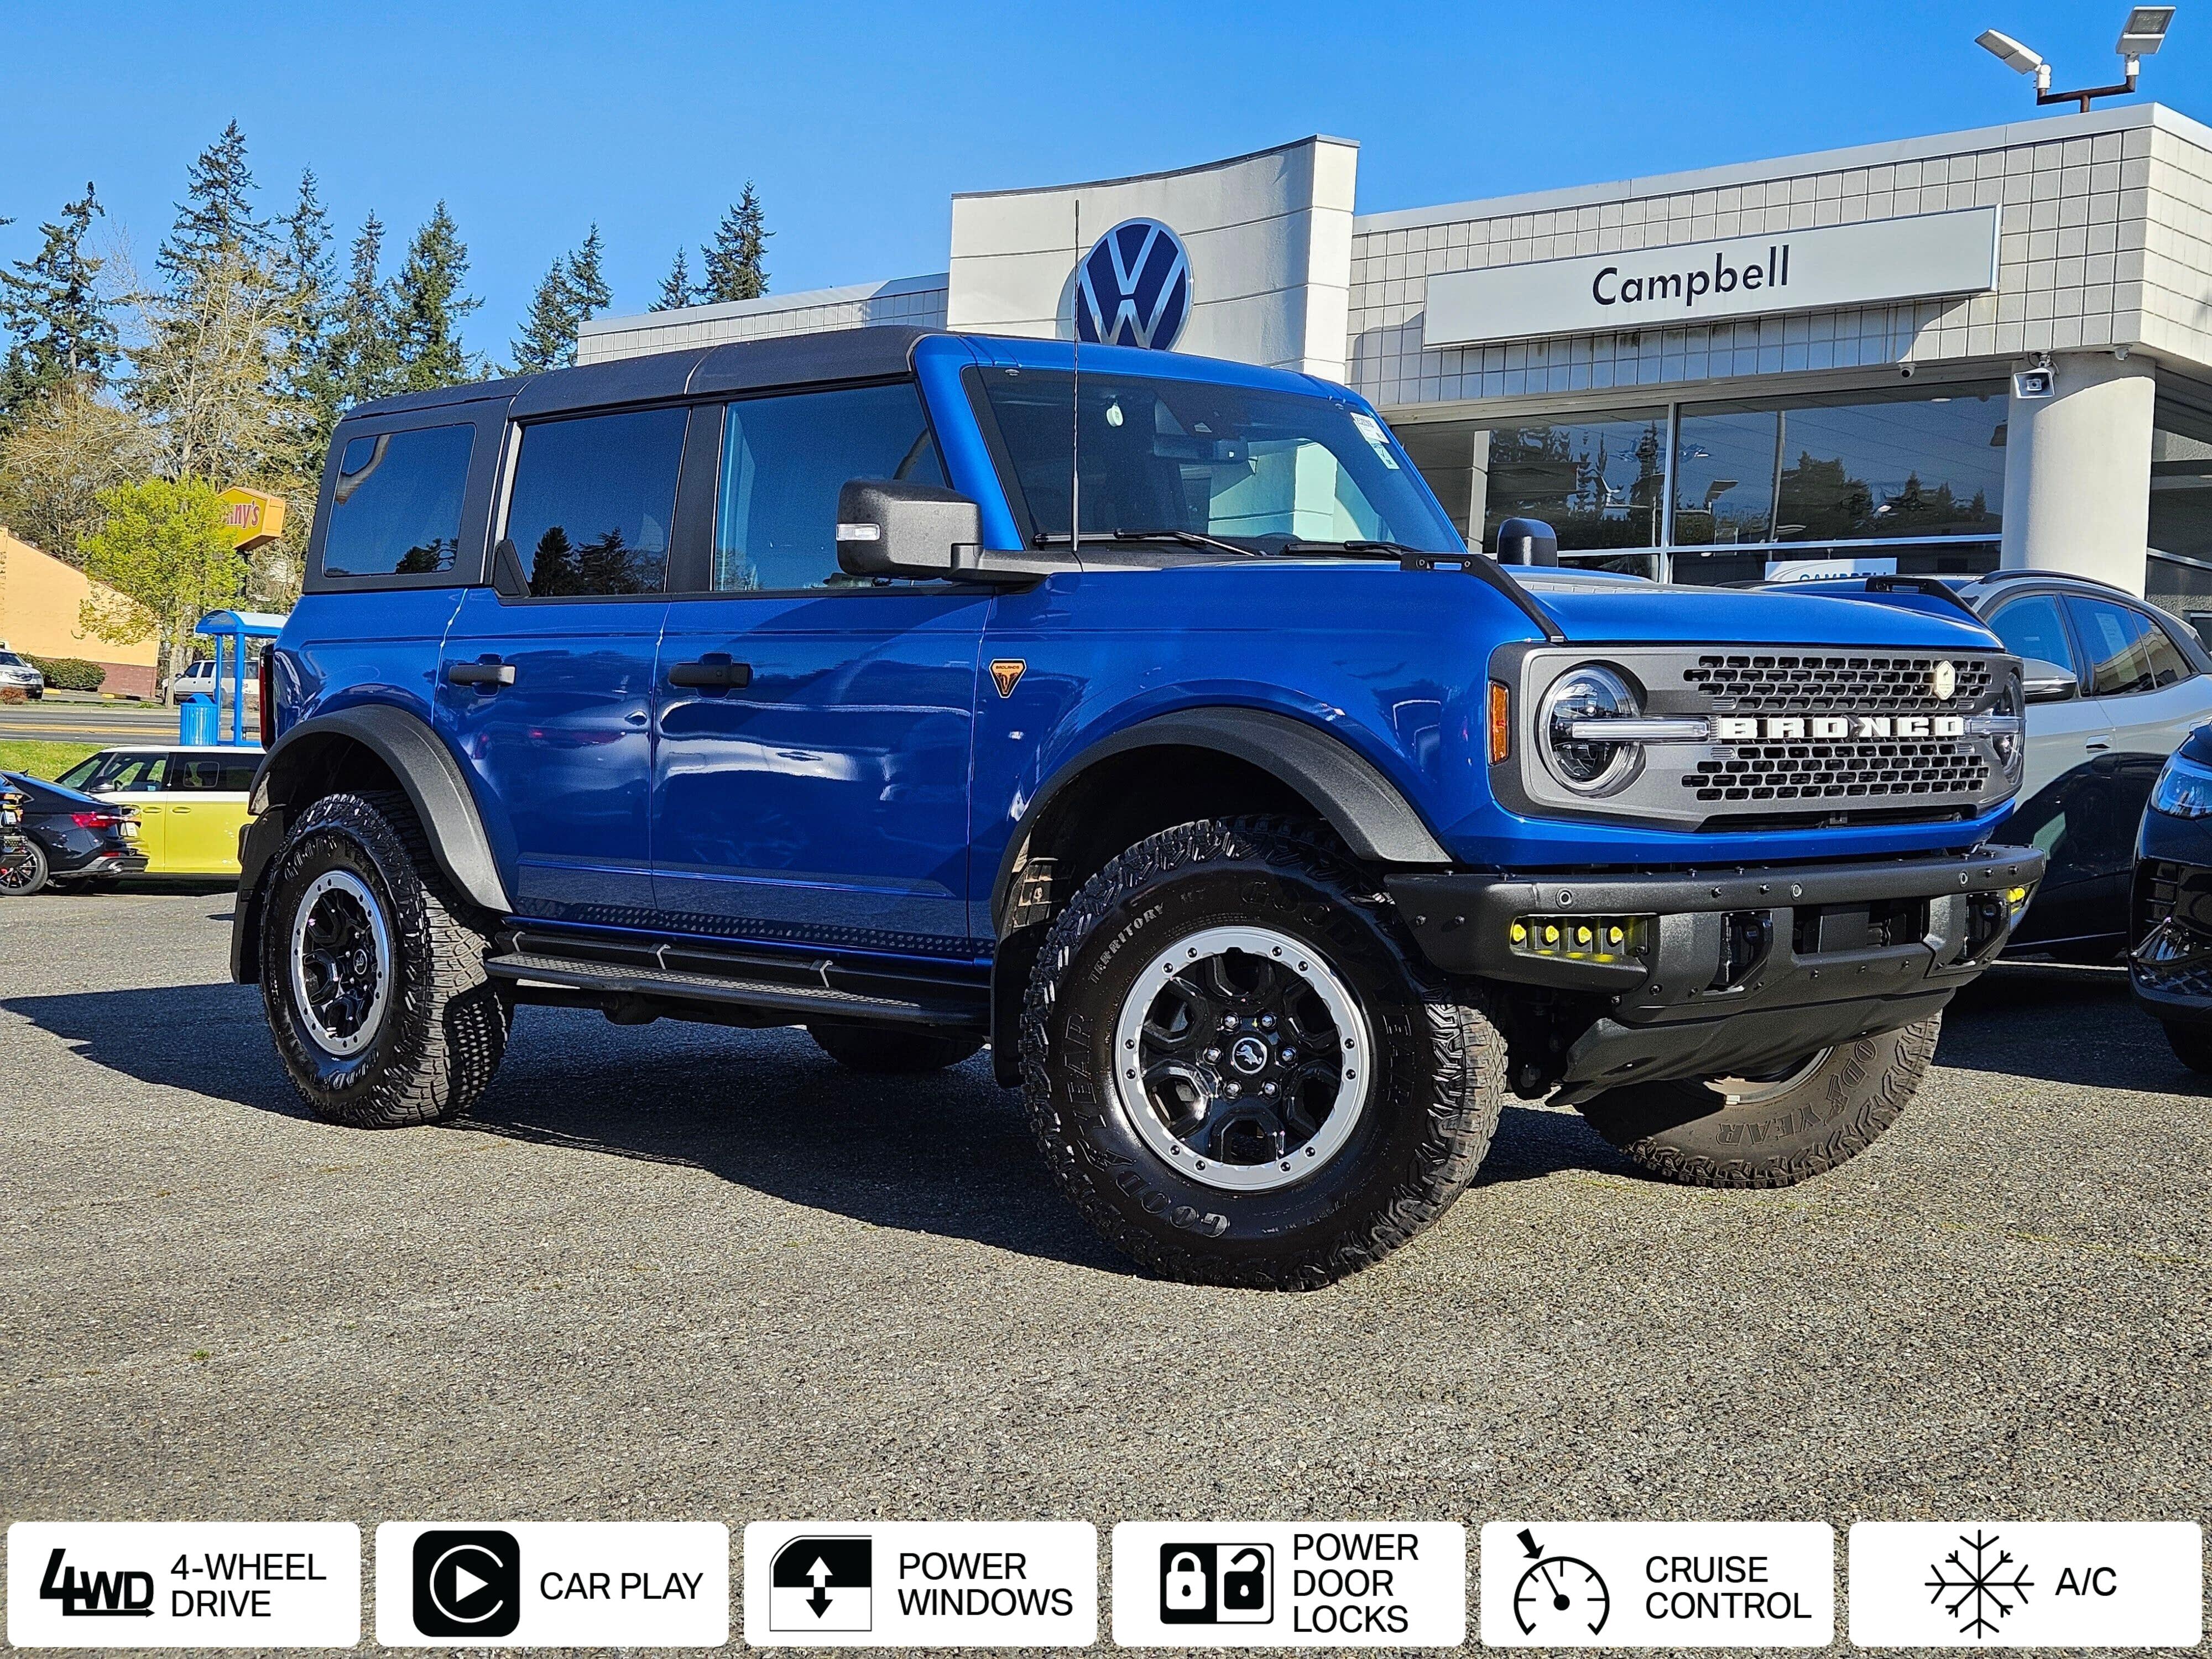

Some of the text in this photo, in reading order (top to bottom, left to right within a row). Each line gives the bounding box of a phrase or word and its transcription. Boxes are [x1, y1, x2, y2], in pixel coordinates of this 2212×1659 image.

[1592, 244, 1790, 307] Campbell
[1718, 717, 1964, 739] BRONCO
[1088, 902, 1164, 984] TERRITORY
